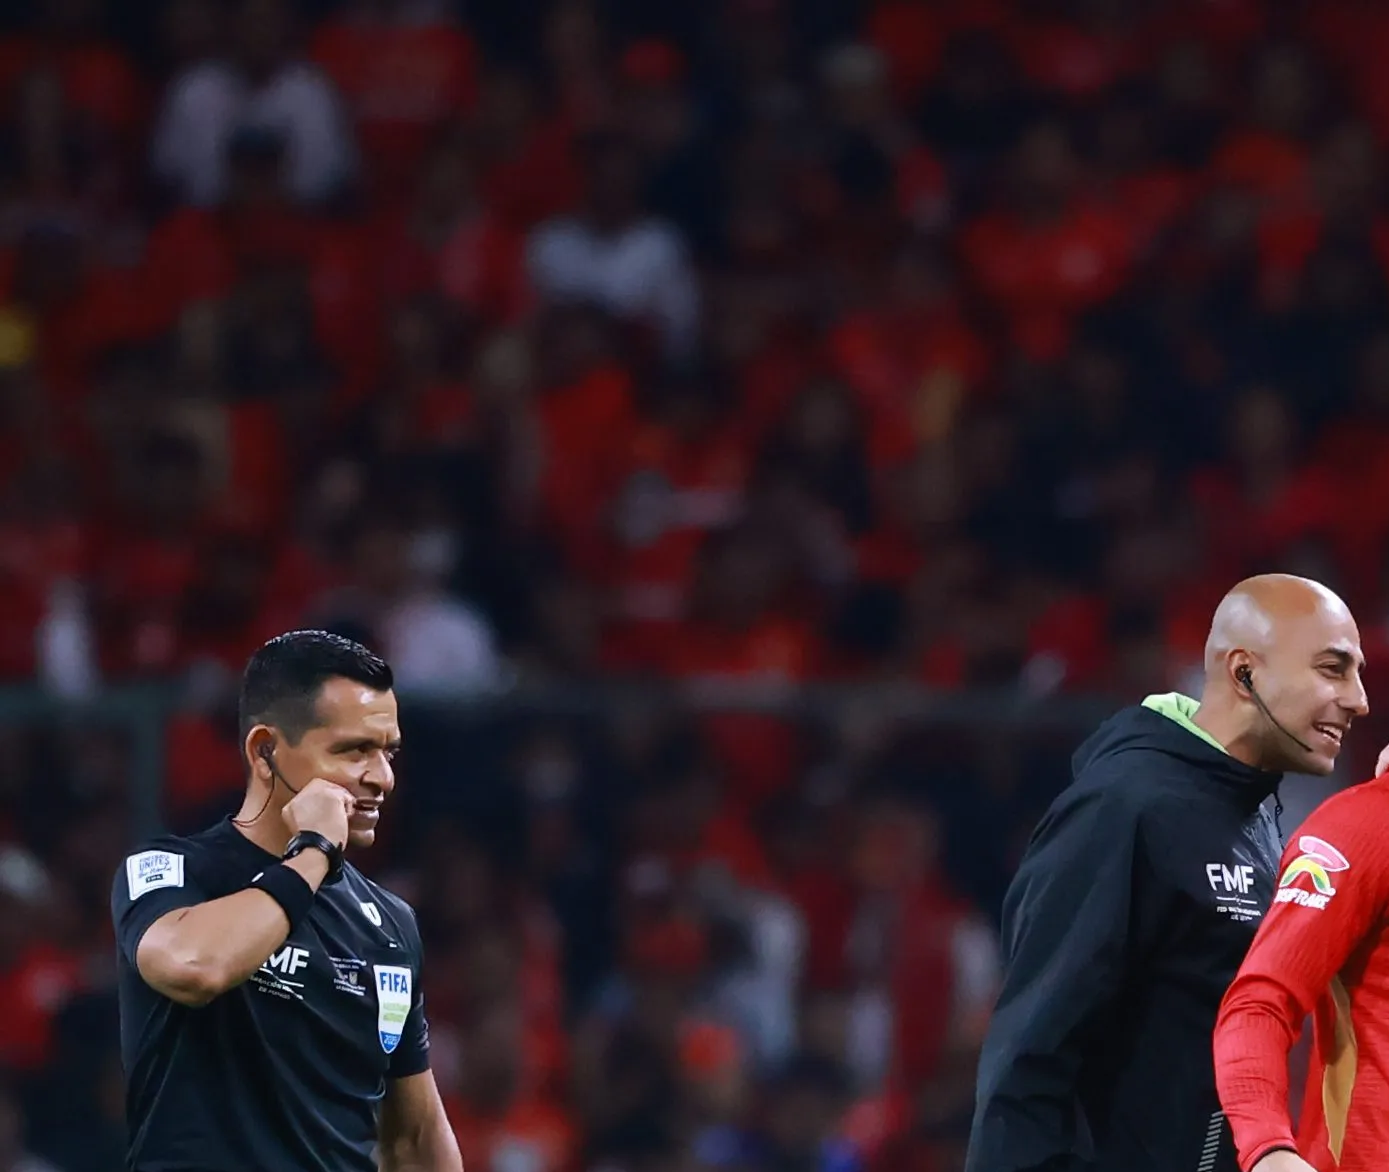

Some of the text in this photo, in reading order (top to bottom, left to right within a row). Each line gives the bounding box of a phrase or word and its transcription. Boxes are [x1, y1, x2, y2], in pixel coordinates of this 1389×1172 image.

[1206, 864, 1254, 894] FMF
[265, 946, 310, 975] MF
[379, 972, 408, 994] FIFA
